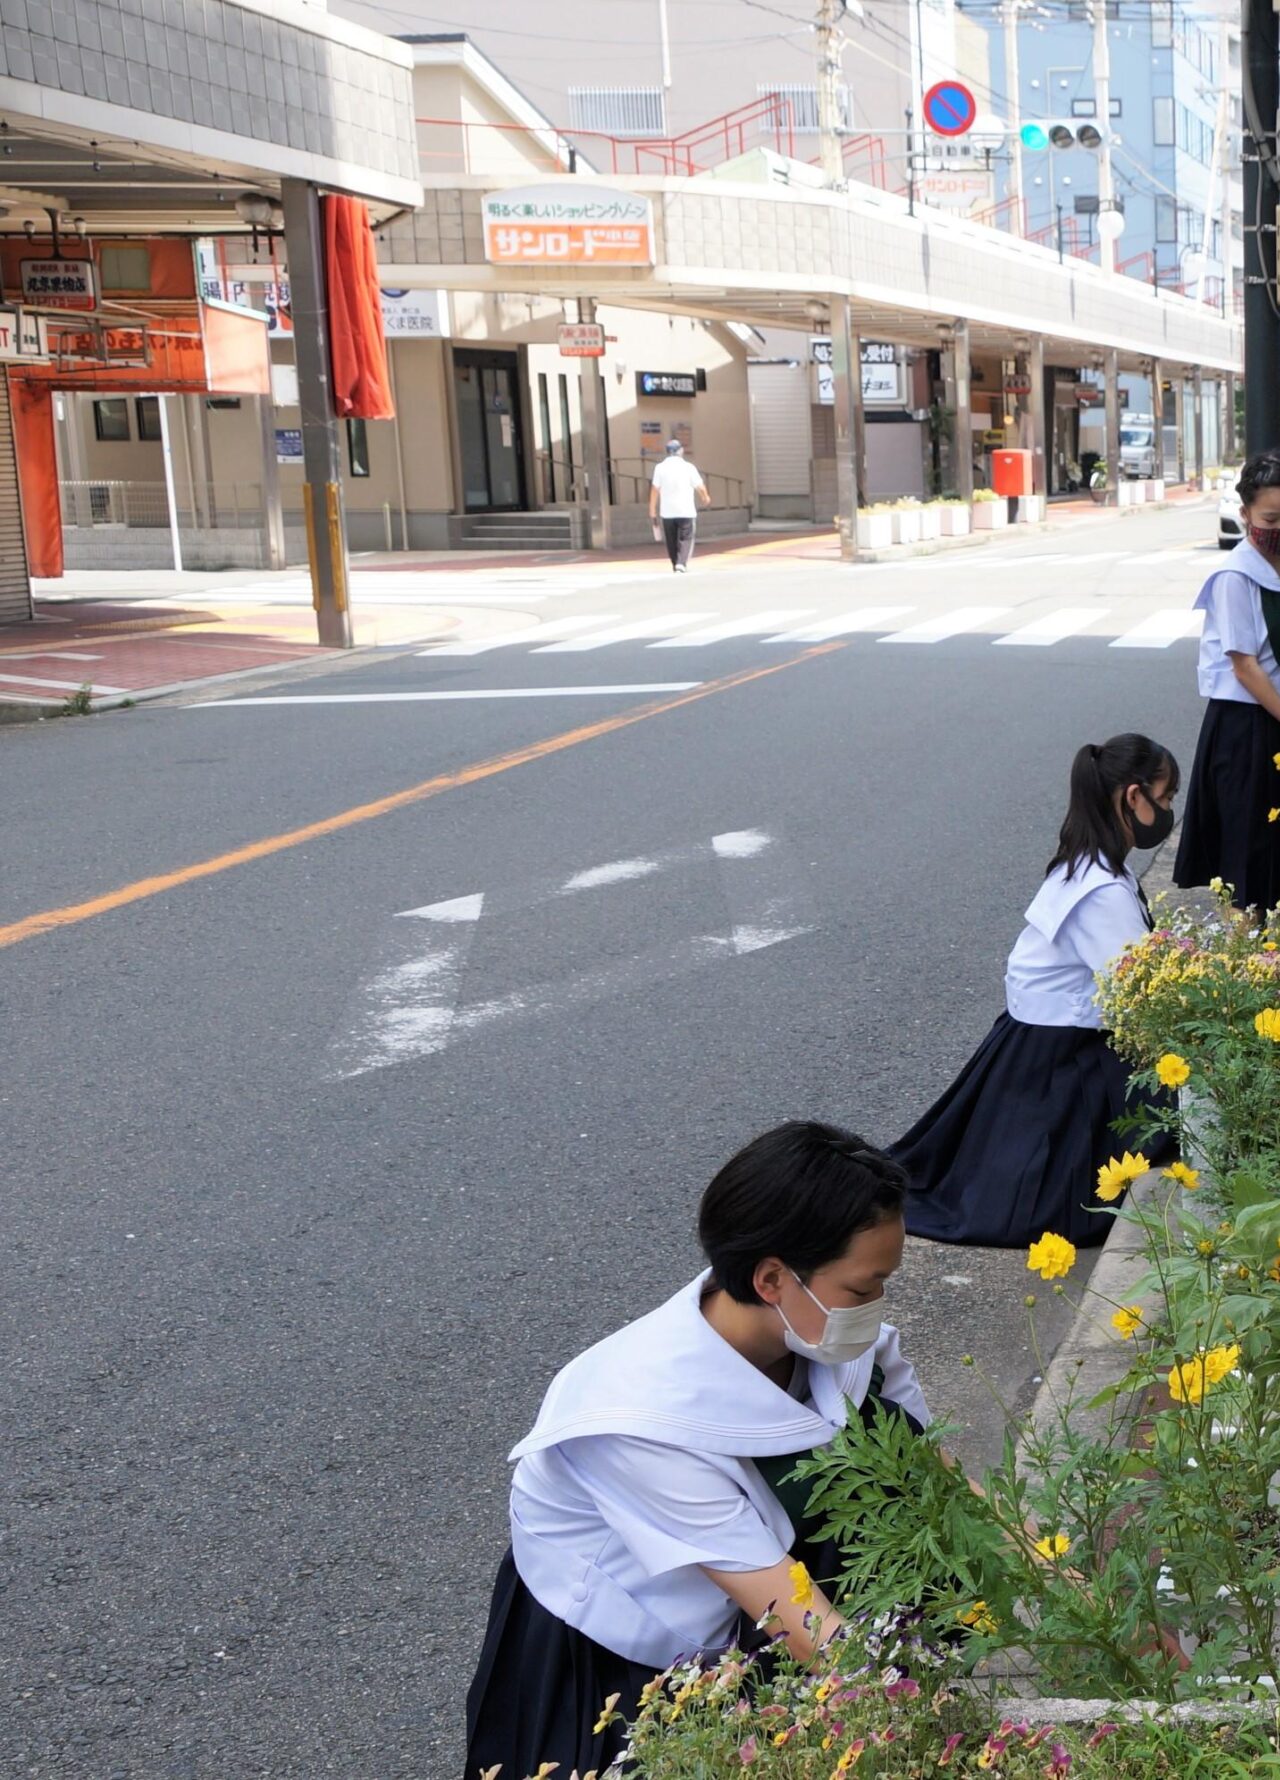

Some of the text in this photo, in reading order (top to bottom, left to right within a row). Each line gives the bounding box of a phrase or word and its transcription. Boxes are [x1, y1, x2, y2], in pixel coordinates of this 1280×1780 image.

[932, 145, 970, 156] 自動車
[488, 202, 646, 219] 明るく楽しいショッピングゾーン
[384, 316, 433, 331] くま医院
